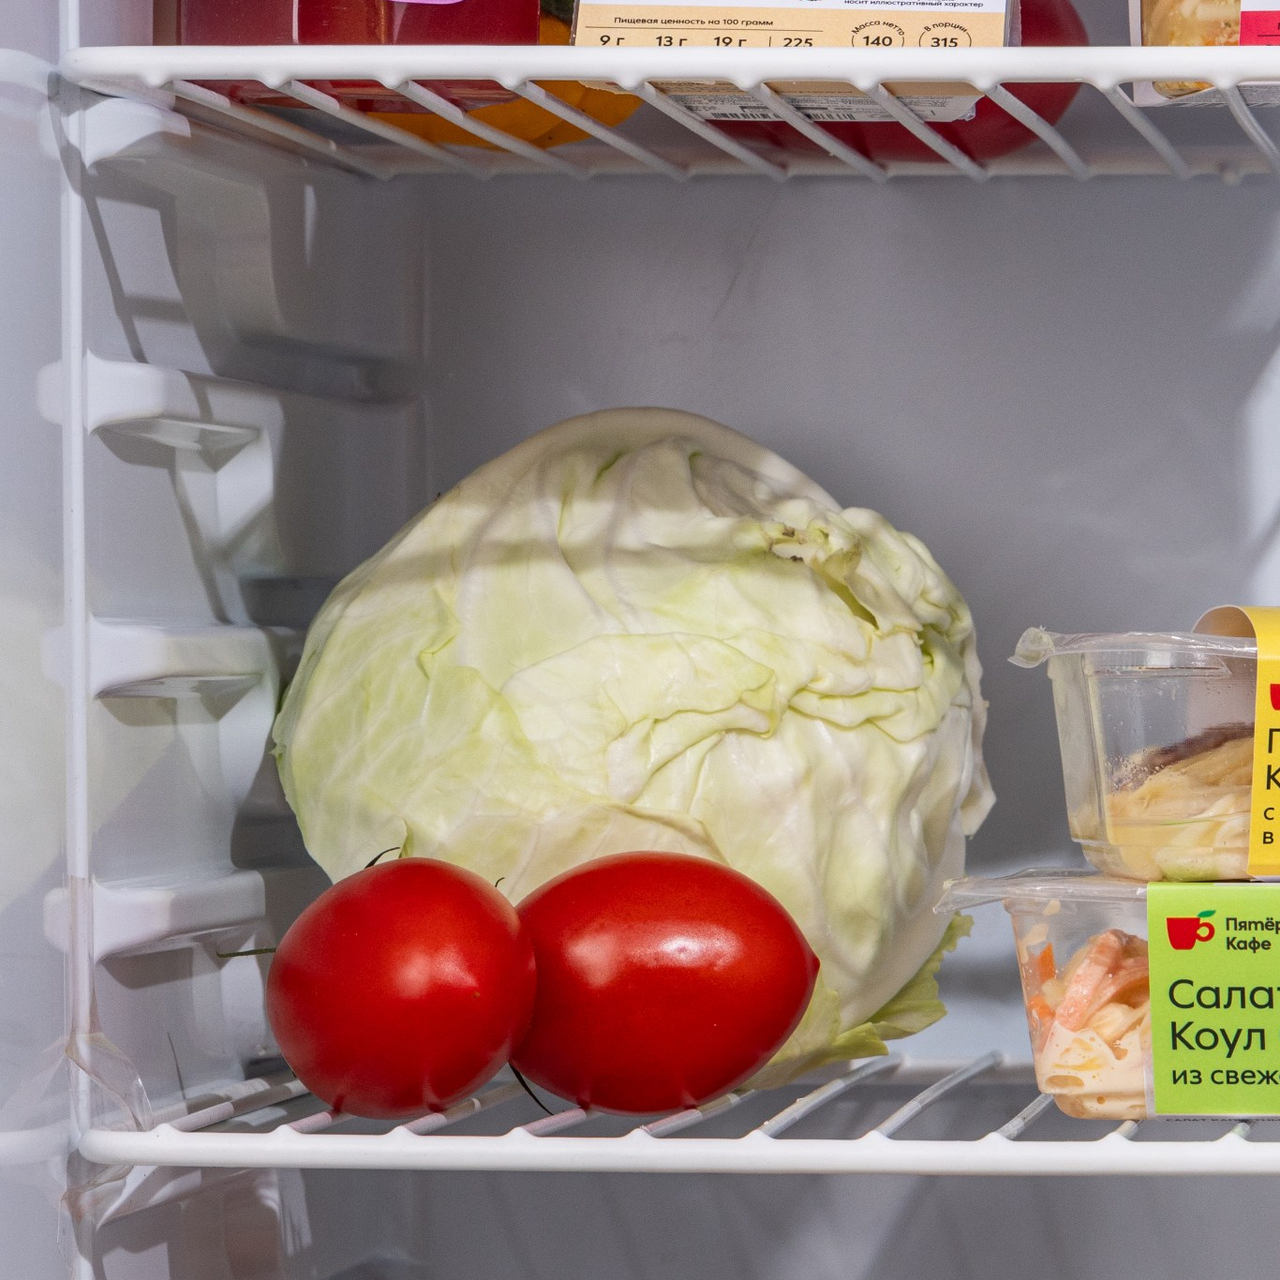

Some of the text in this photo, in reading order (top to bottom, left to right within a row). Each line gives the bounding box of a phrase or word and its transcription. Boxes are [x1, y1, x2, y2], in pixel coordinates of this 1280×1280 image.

[851, 20, 905, 36] Масса нетто
[932, 22, 968, 33] порции
[600, 35, 625, 46] 9 г
[655, 36, 688, 47] 13 г
[714, 37, 747, 47] 19 г
[783, 38, 813, 47] 225
[863, 36, 892, 47] 140
[931, 37, 958, 47] 315
[1264, 806, 1274, 820] с
[1262, 831, 1274, 844] в
[1226, 937, 1271, 953] Кафе
[1170, 1021, 1266, 1058] Коул
[1171, 1069, 1203, 1085] из
